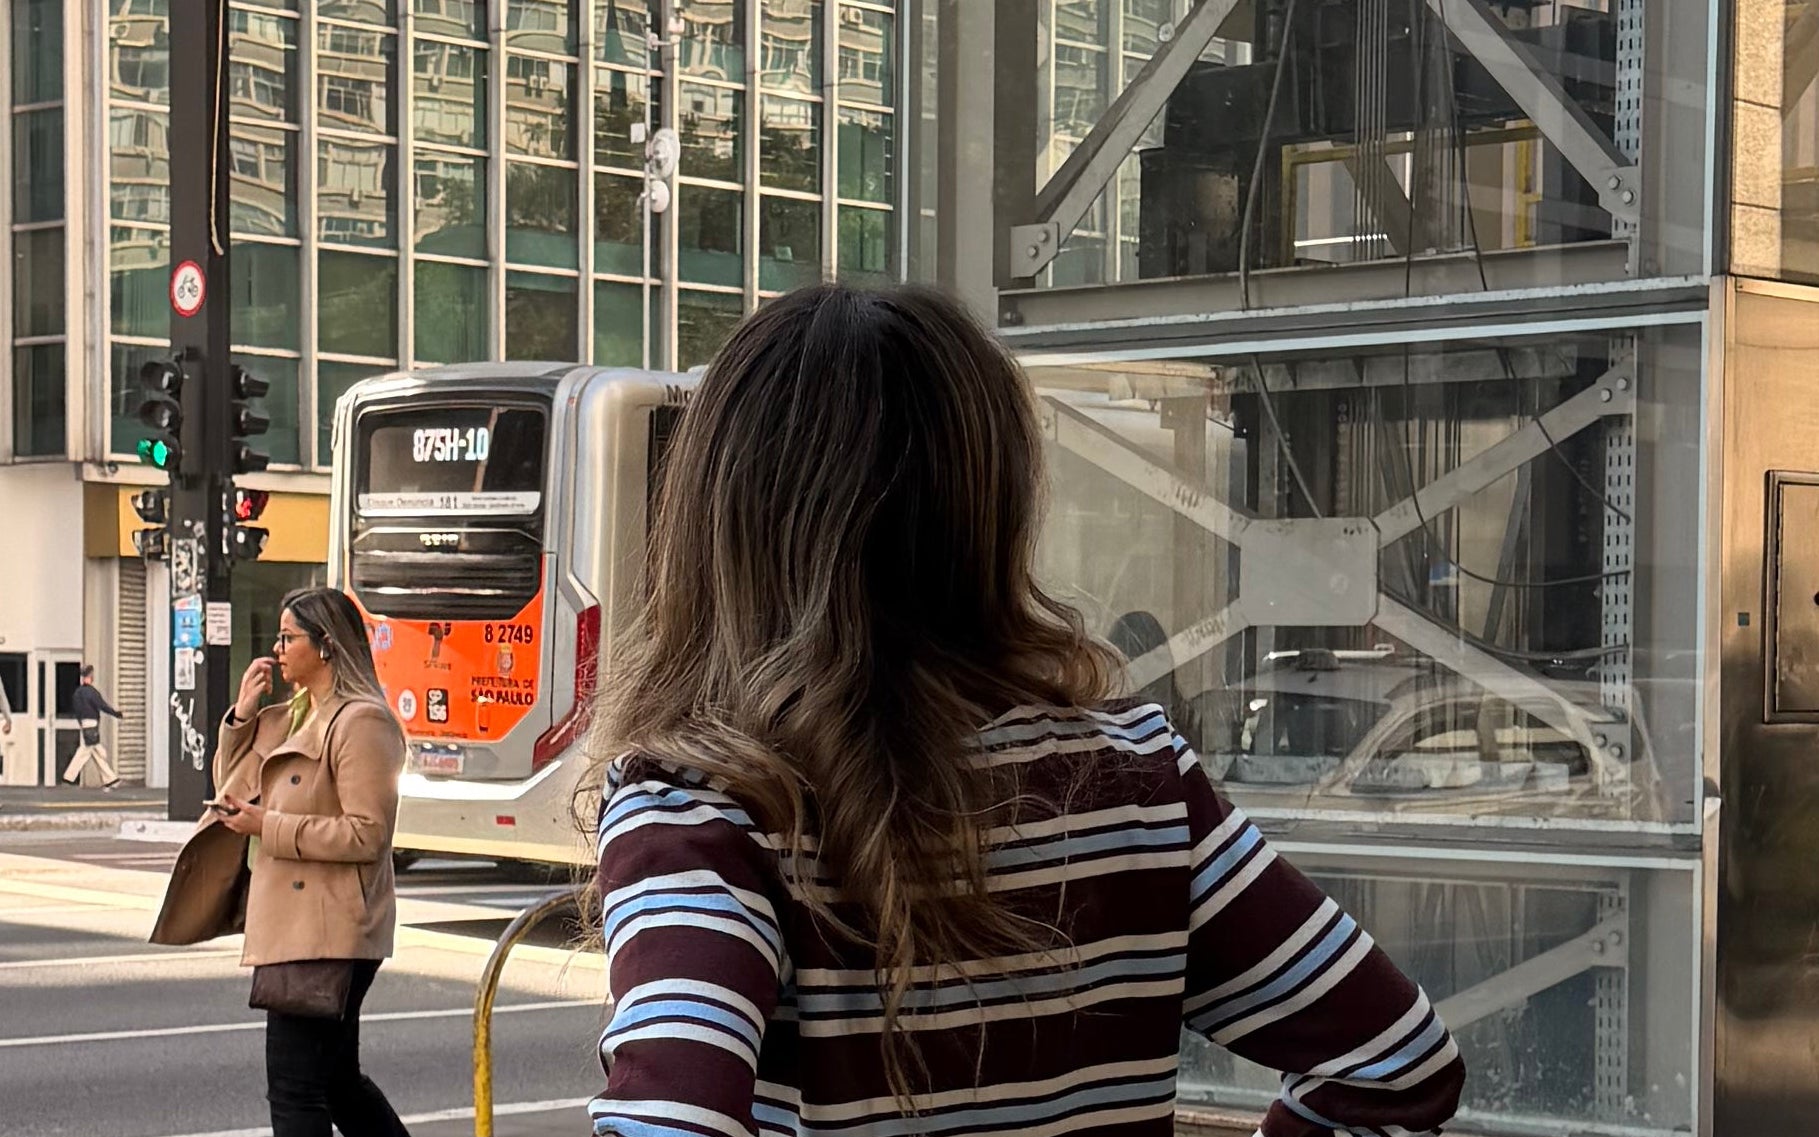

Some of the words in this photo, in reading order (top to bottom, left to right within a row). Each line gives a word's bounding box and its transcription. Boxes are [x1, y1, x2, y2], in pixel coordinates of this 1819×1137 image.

[413, 427, 490, 462] 875H-10
[484, 624, 494, 643] 8
[497, 624, 533, 644] 2749
